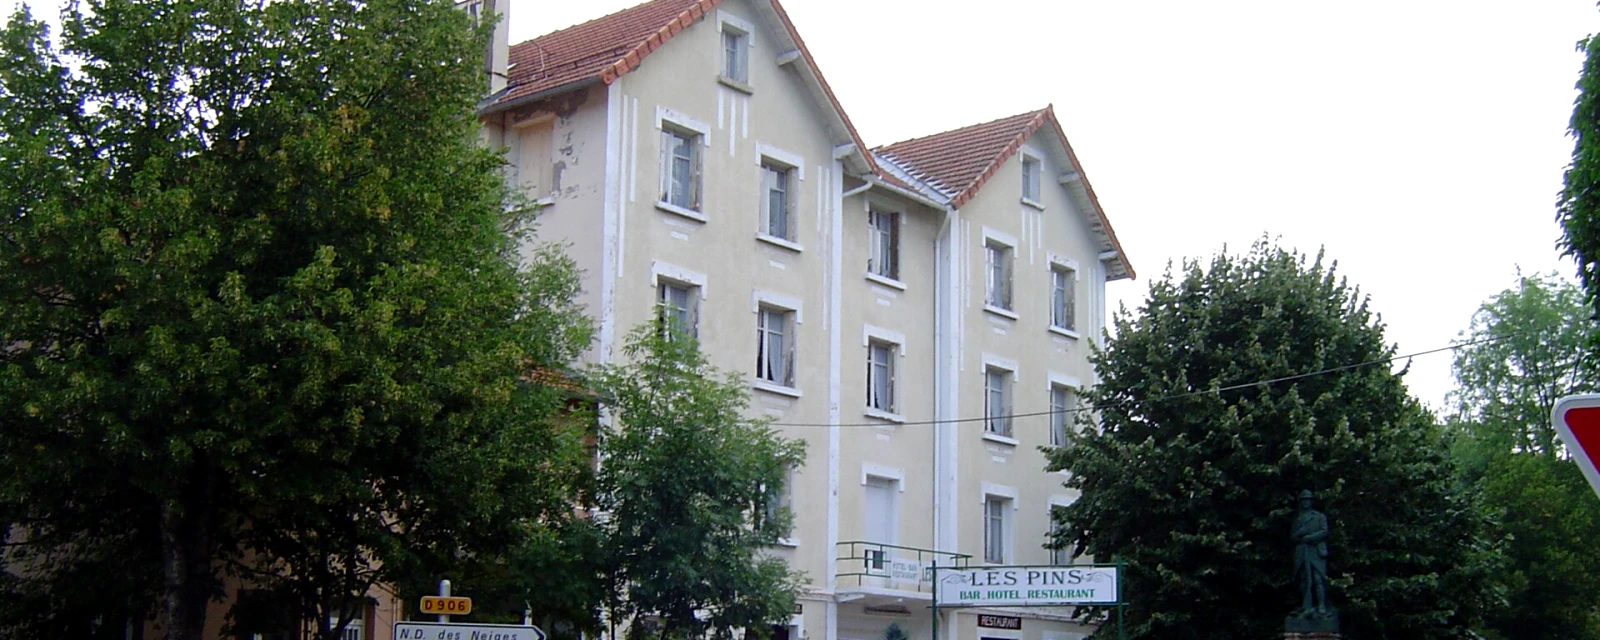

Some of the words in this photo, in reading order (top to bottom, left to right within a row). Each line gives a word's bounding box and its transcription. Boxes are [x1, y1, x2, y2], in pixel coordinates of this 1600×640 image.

[970, 571, 1017, 586] LES
[1028, 570, 1082, 585] PINS
[959, 590, 981, 600] BAR
[987, 590, 1021, 599] HOTEL
[1027, 589, 1095, 599] RESTAURANT
[425, 601, 433, 610] D
[437, 601, 466, 611] 906
[981, 615, 1020, 628] RESTAURANT
[400, 629, 426, 640] N.D.
[438, 629, 461, 640] des
[471, 630, 518, 640] Neiges
